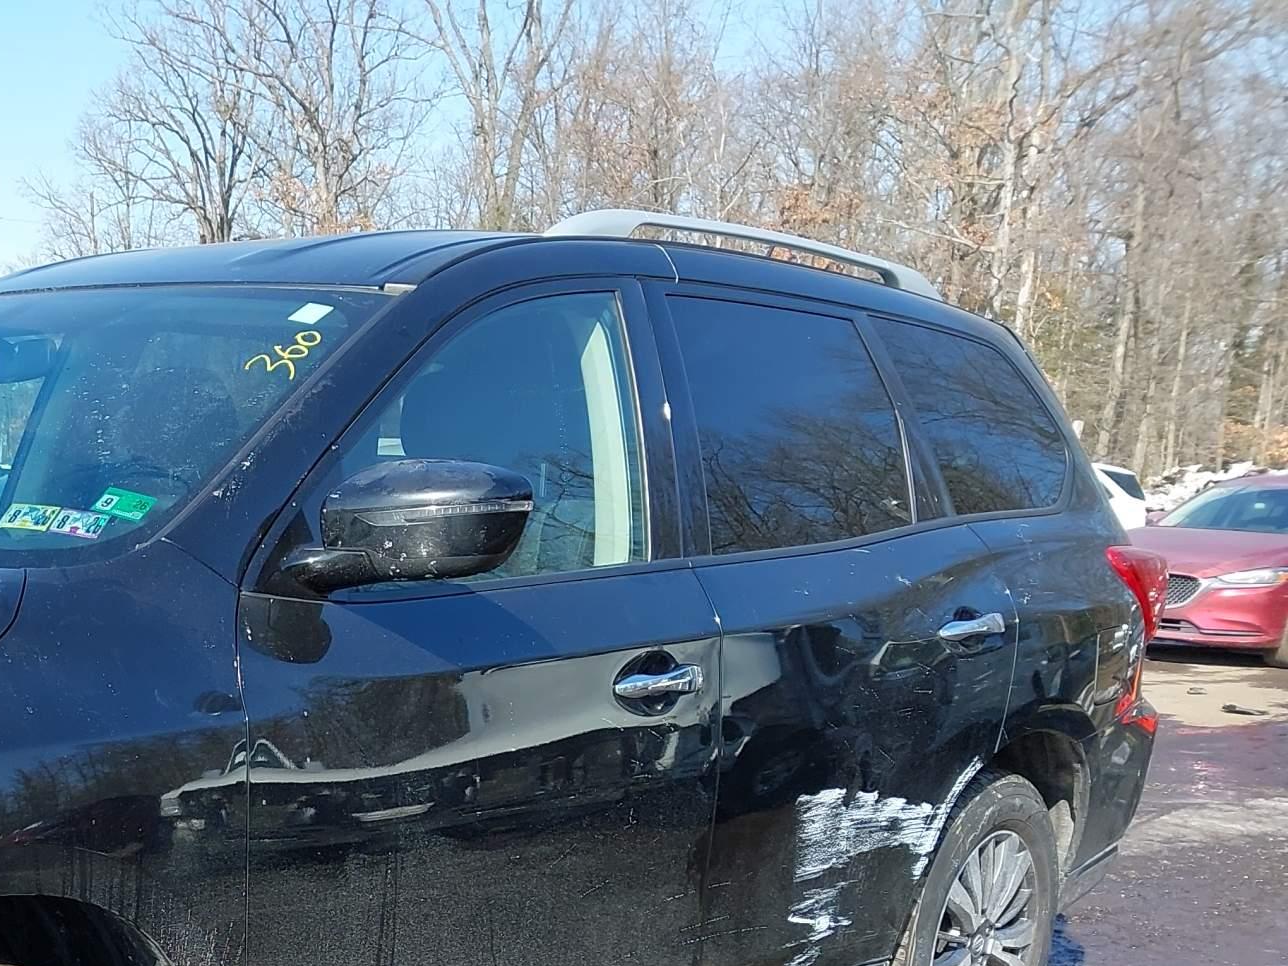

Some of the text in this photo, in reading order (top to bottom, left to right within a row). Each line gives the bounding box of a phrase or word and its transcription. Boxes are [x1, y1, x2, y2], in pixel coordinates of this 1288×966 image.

[244, 330, 322, 381] 360
[101, 497, 149, 511] 9 26
[7, 509, 22, 523] 8
[57, 514, 70, 529] 8
